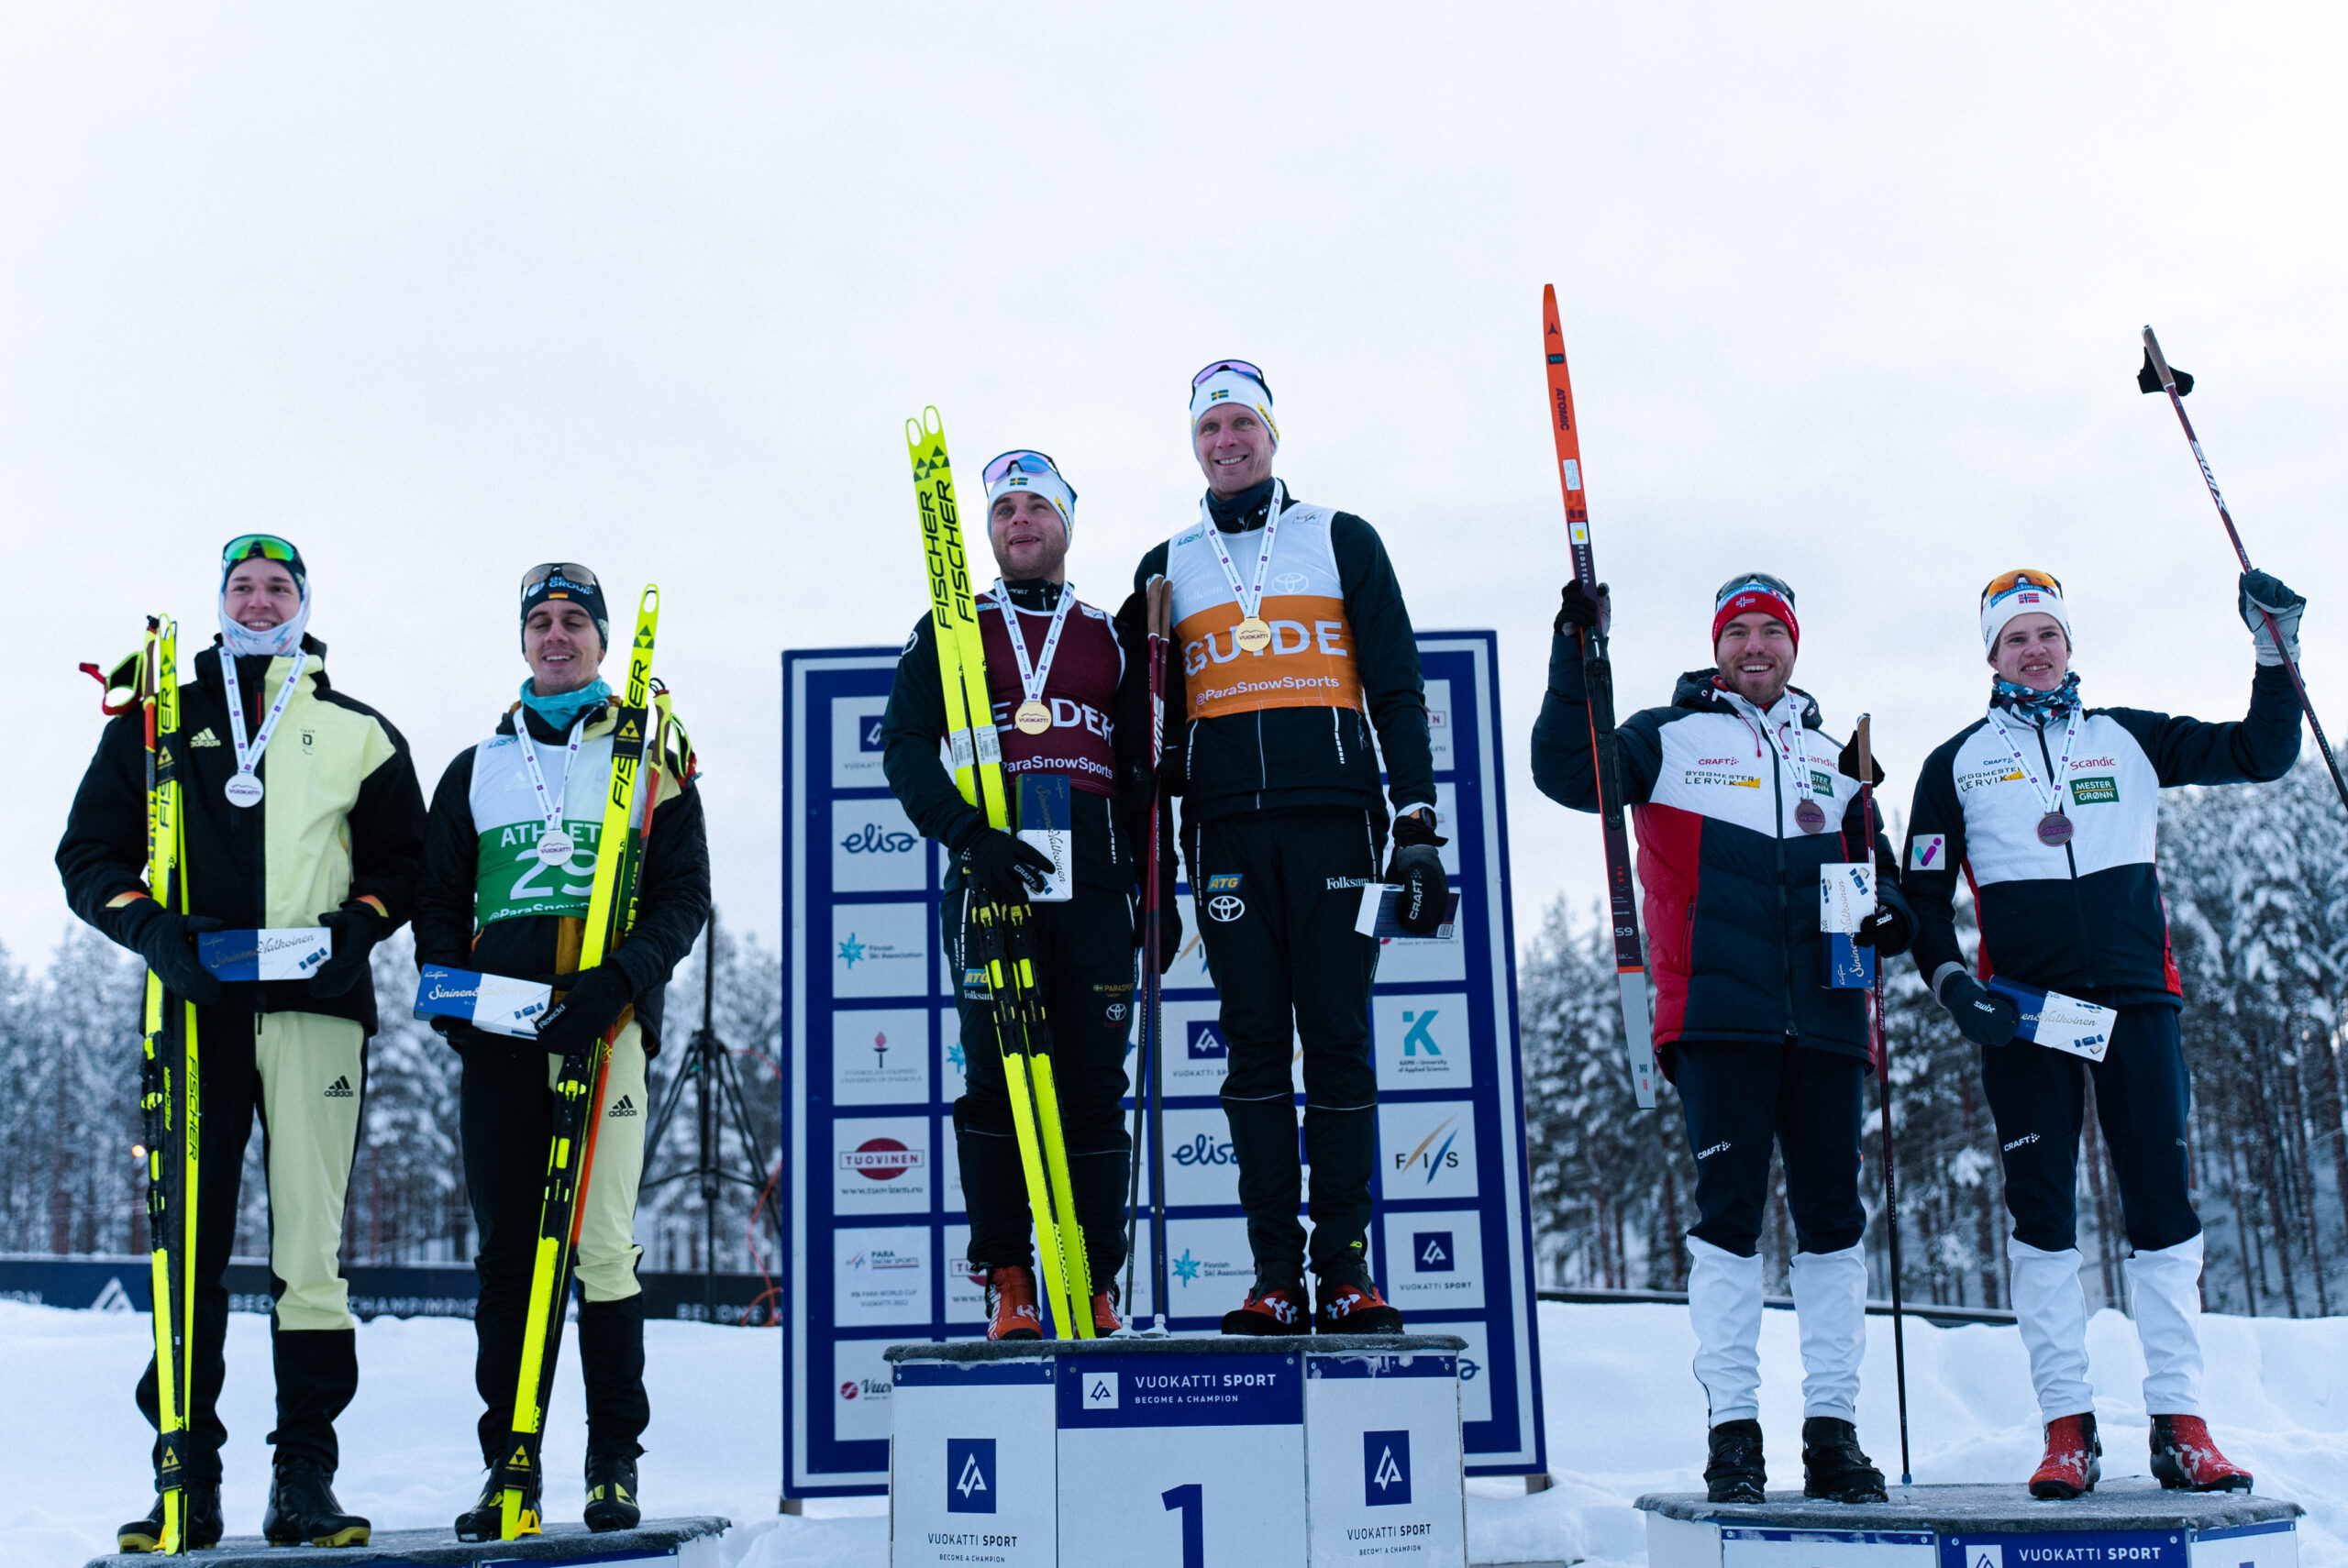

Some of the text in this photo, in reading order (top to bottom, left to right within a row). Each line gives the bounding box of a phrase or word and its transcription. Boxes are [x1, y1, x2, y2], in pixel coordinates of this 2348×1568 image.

[1556, 388, 1569, 431] ATOMIC
[936, 480, 974, 624] FISCHER
[920, 491, 952, 630] FISCHER
[1184, 620, 1347, 676] GUDE
[1196, 676, 1340, 705] @ParaSnowSports
[1698, 757, 1731, 766] CRAFT
[1983, 757, 2007, 766] CRAFT
[2070, 756, 2117, 771] Scandic
[1685, 770, 1755, 782] BYGGMESTER
[1685, 778, 1736, 787] LERVIK
[1811, 774, 1829, 784] STER
[1956, 766, 2020, 784] BYGGMESTE
[1960, 774, 2007, 792] LERVIK
[2076, 780, 2112, 791] MESTER
[2079, 790, 2114, 801] GRØNN
[840, 823, 919, 854] elisa
[510, 848, 598, 900] 29
[1209, 878, 1239, 889] ATG
[1410, 879, 1423, 921] CRAFT
[189, 1055, 198, 1161] FISCHER
[608, 1109, 637, 1117] adidas
[2004, 1135, 2031, 1152] CRAFT
[1697, 1143, 1722, 1160] CRAFT
[845, 1154, 919, 1165] TUOVINEN
[1135, 1374, 1276, 1388] VUOKATTI SPORT
[1135, 1396, 1174, 1404] BECOME
[1187, 1395, 1238, 1403] CHAMPION
[1161, 1484, 1204, 1568] 1
[1347, 1523, 1431, 1540] VUOKATTI SPORT
[927, 1532, 1018, 1548] VUOKATTI SPORT
[1390, 1544, 1422, 1553] CHAMPION
[2019, 1547, 2162, 1562] VUOKATTI SPORT
[939, 1553, 963, 1562] BECOME
[972, 1555, 1005, 1563] CHAMPION
